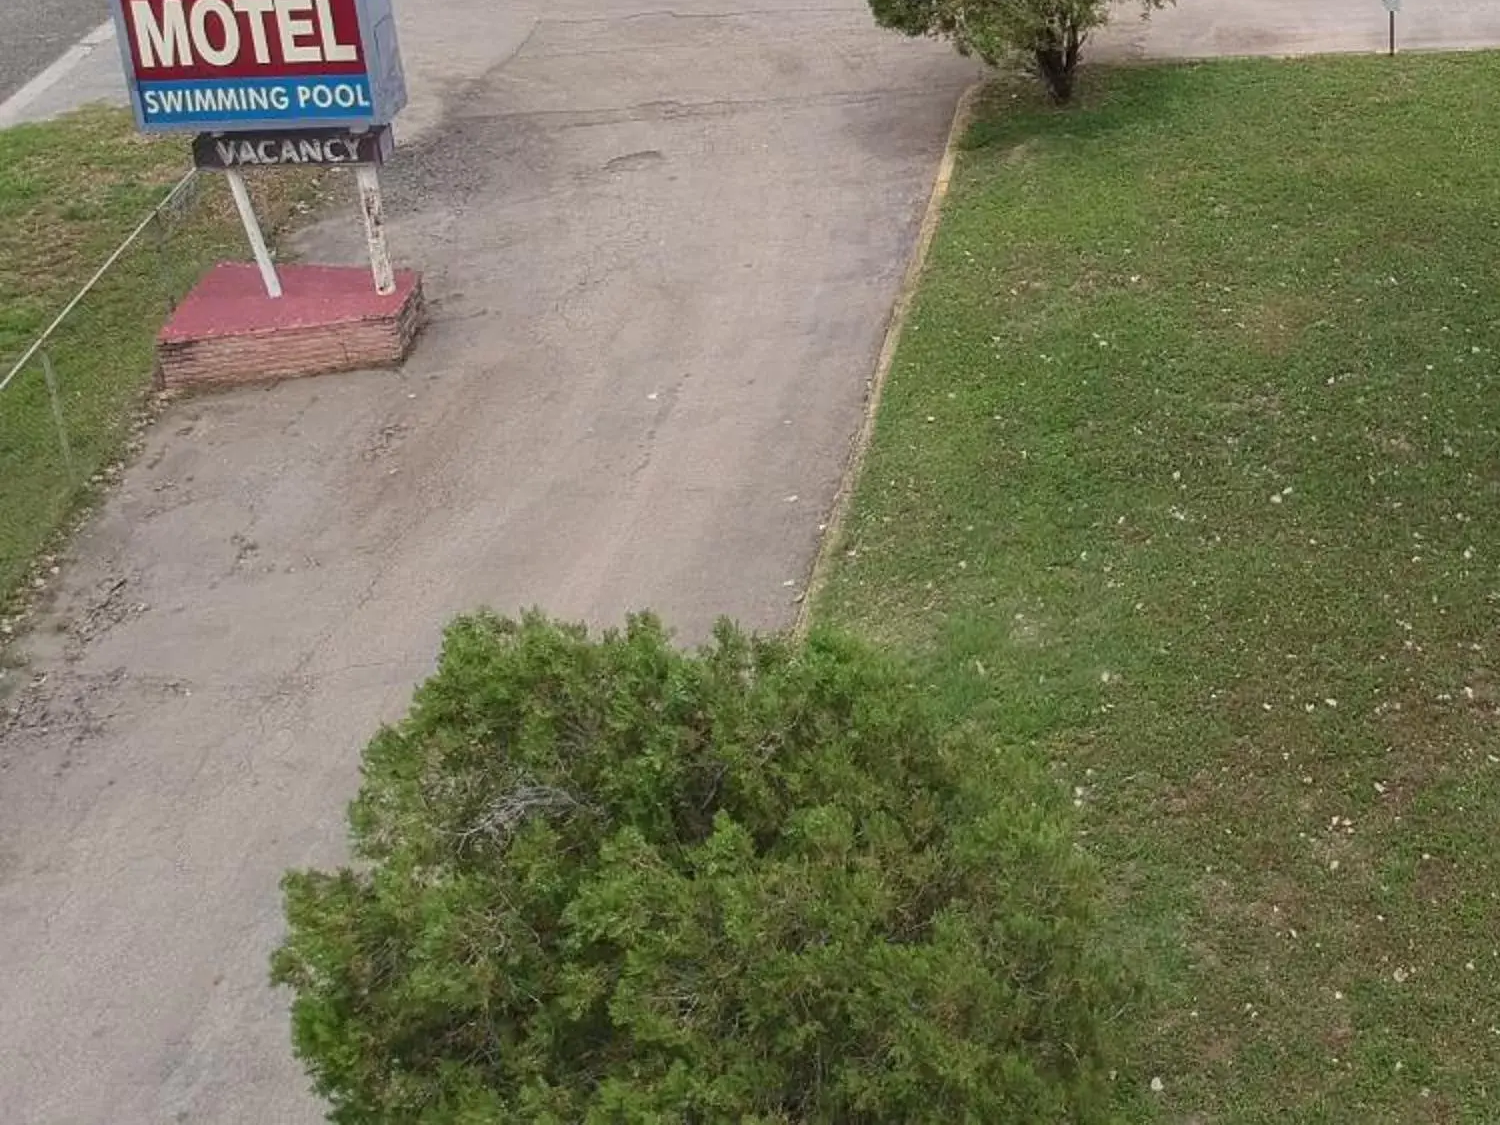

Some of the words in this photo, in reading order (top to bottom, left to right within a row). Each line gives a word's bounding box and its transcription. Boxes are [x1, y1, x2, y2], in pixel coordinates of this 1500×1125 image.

[144, 85, 290, 114] SWIMMING
[297, 83, 371, 108] POOL
[214, 138, 362, 166] VACANCY
